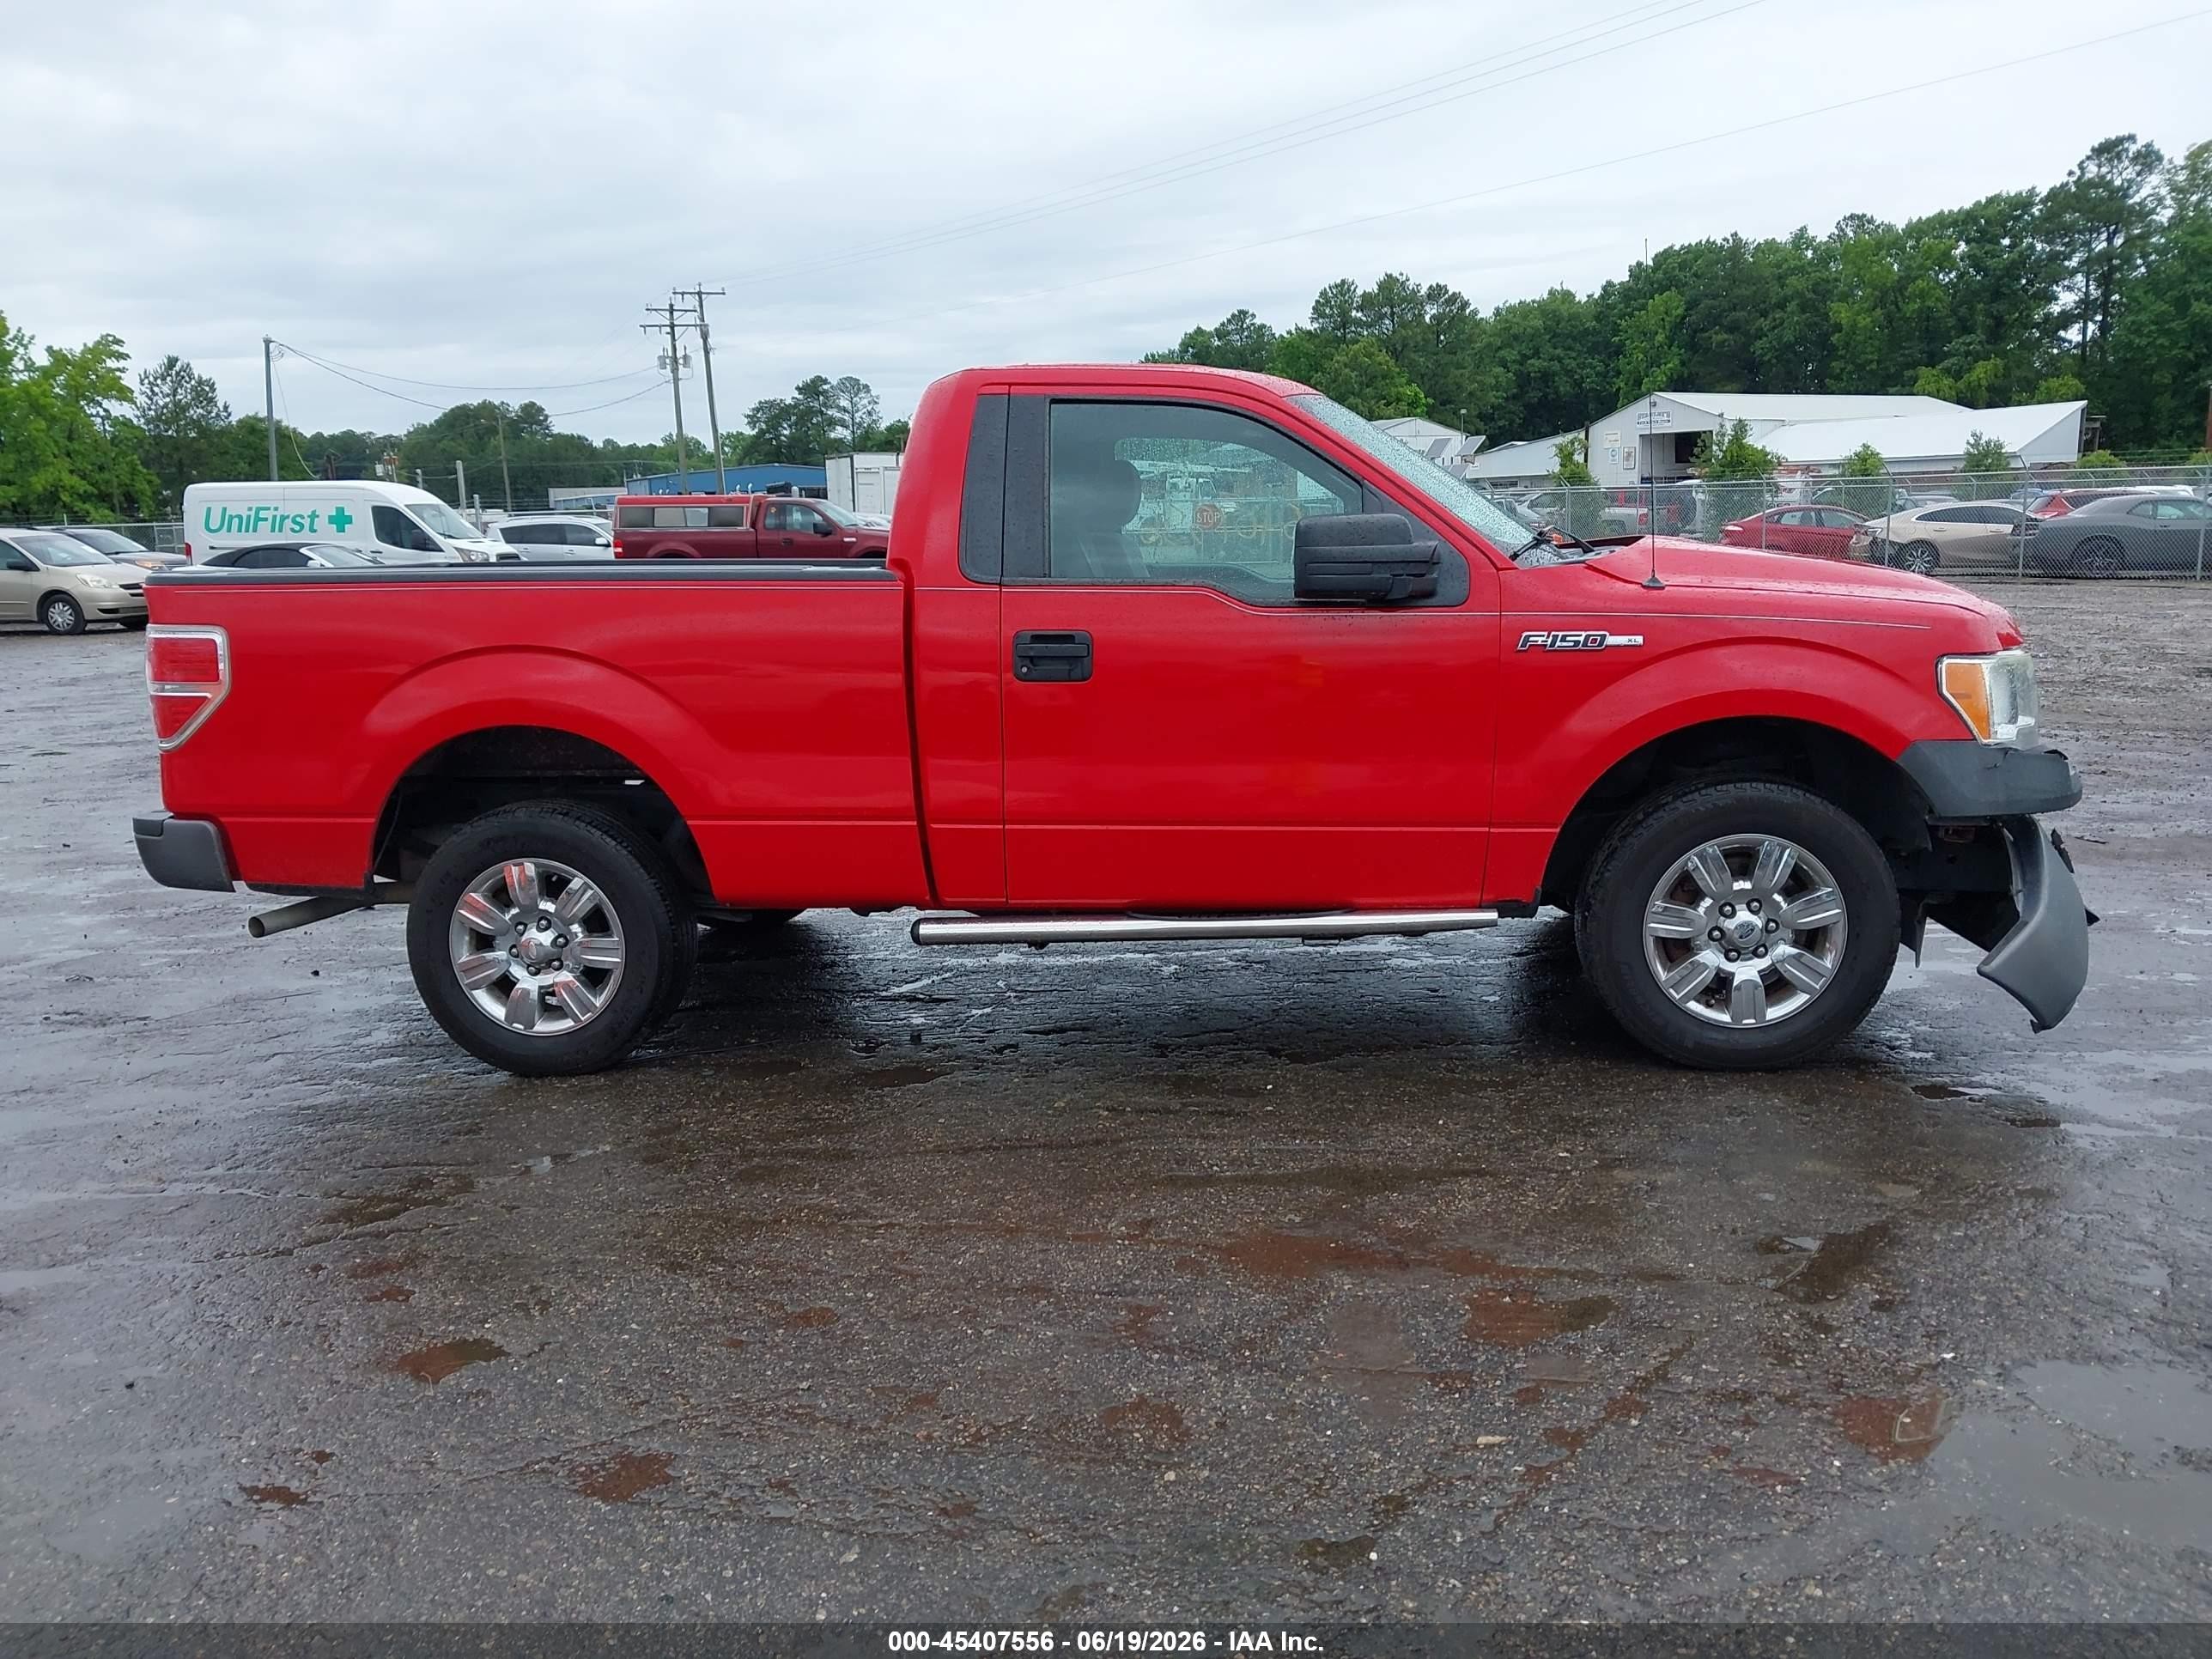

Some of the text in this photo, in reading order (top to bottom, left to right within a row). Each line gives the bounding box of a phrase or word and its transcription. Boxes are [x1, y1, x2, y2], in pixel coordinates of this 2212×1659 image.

[204, 507, 319, 533] UniFirst
[1196, 512, 1220, 523] STOP
[1517, 631, 1610, 650] F-150
